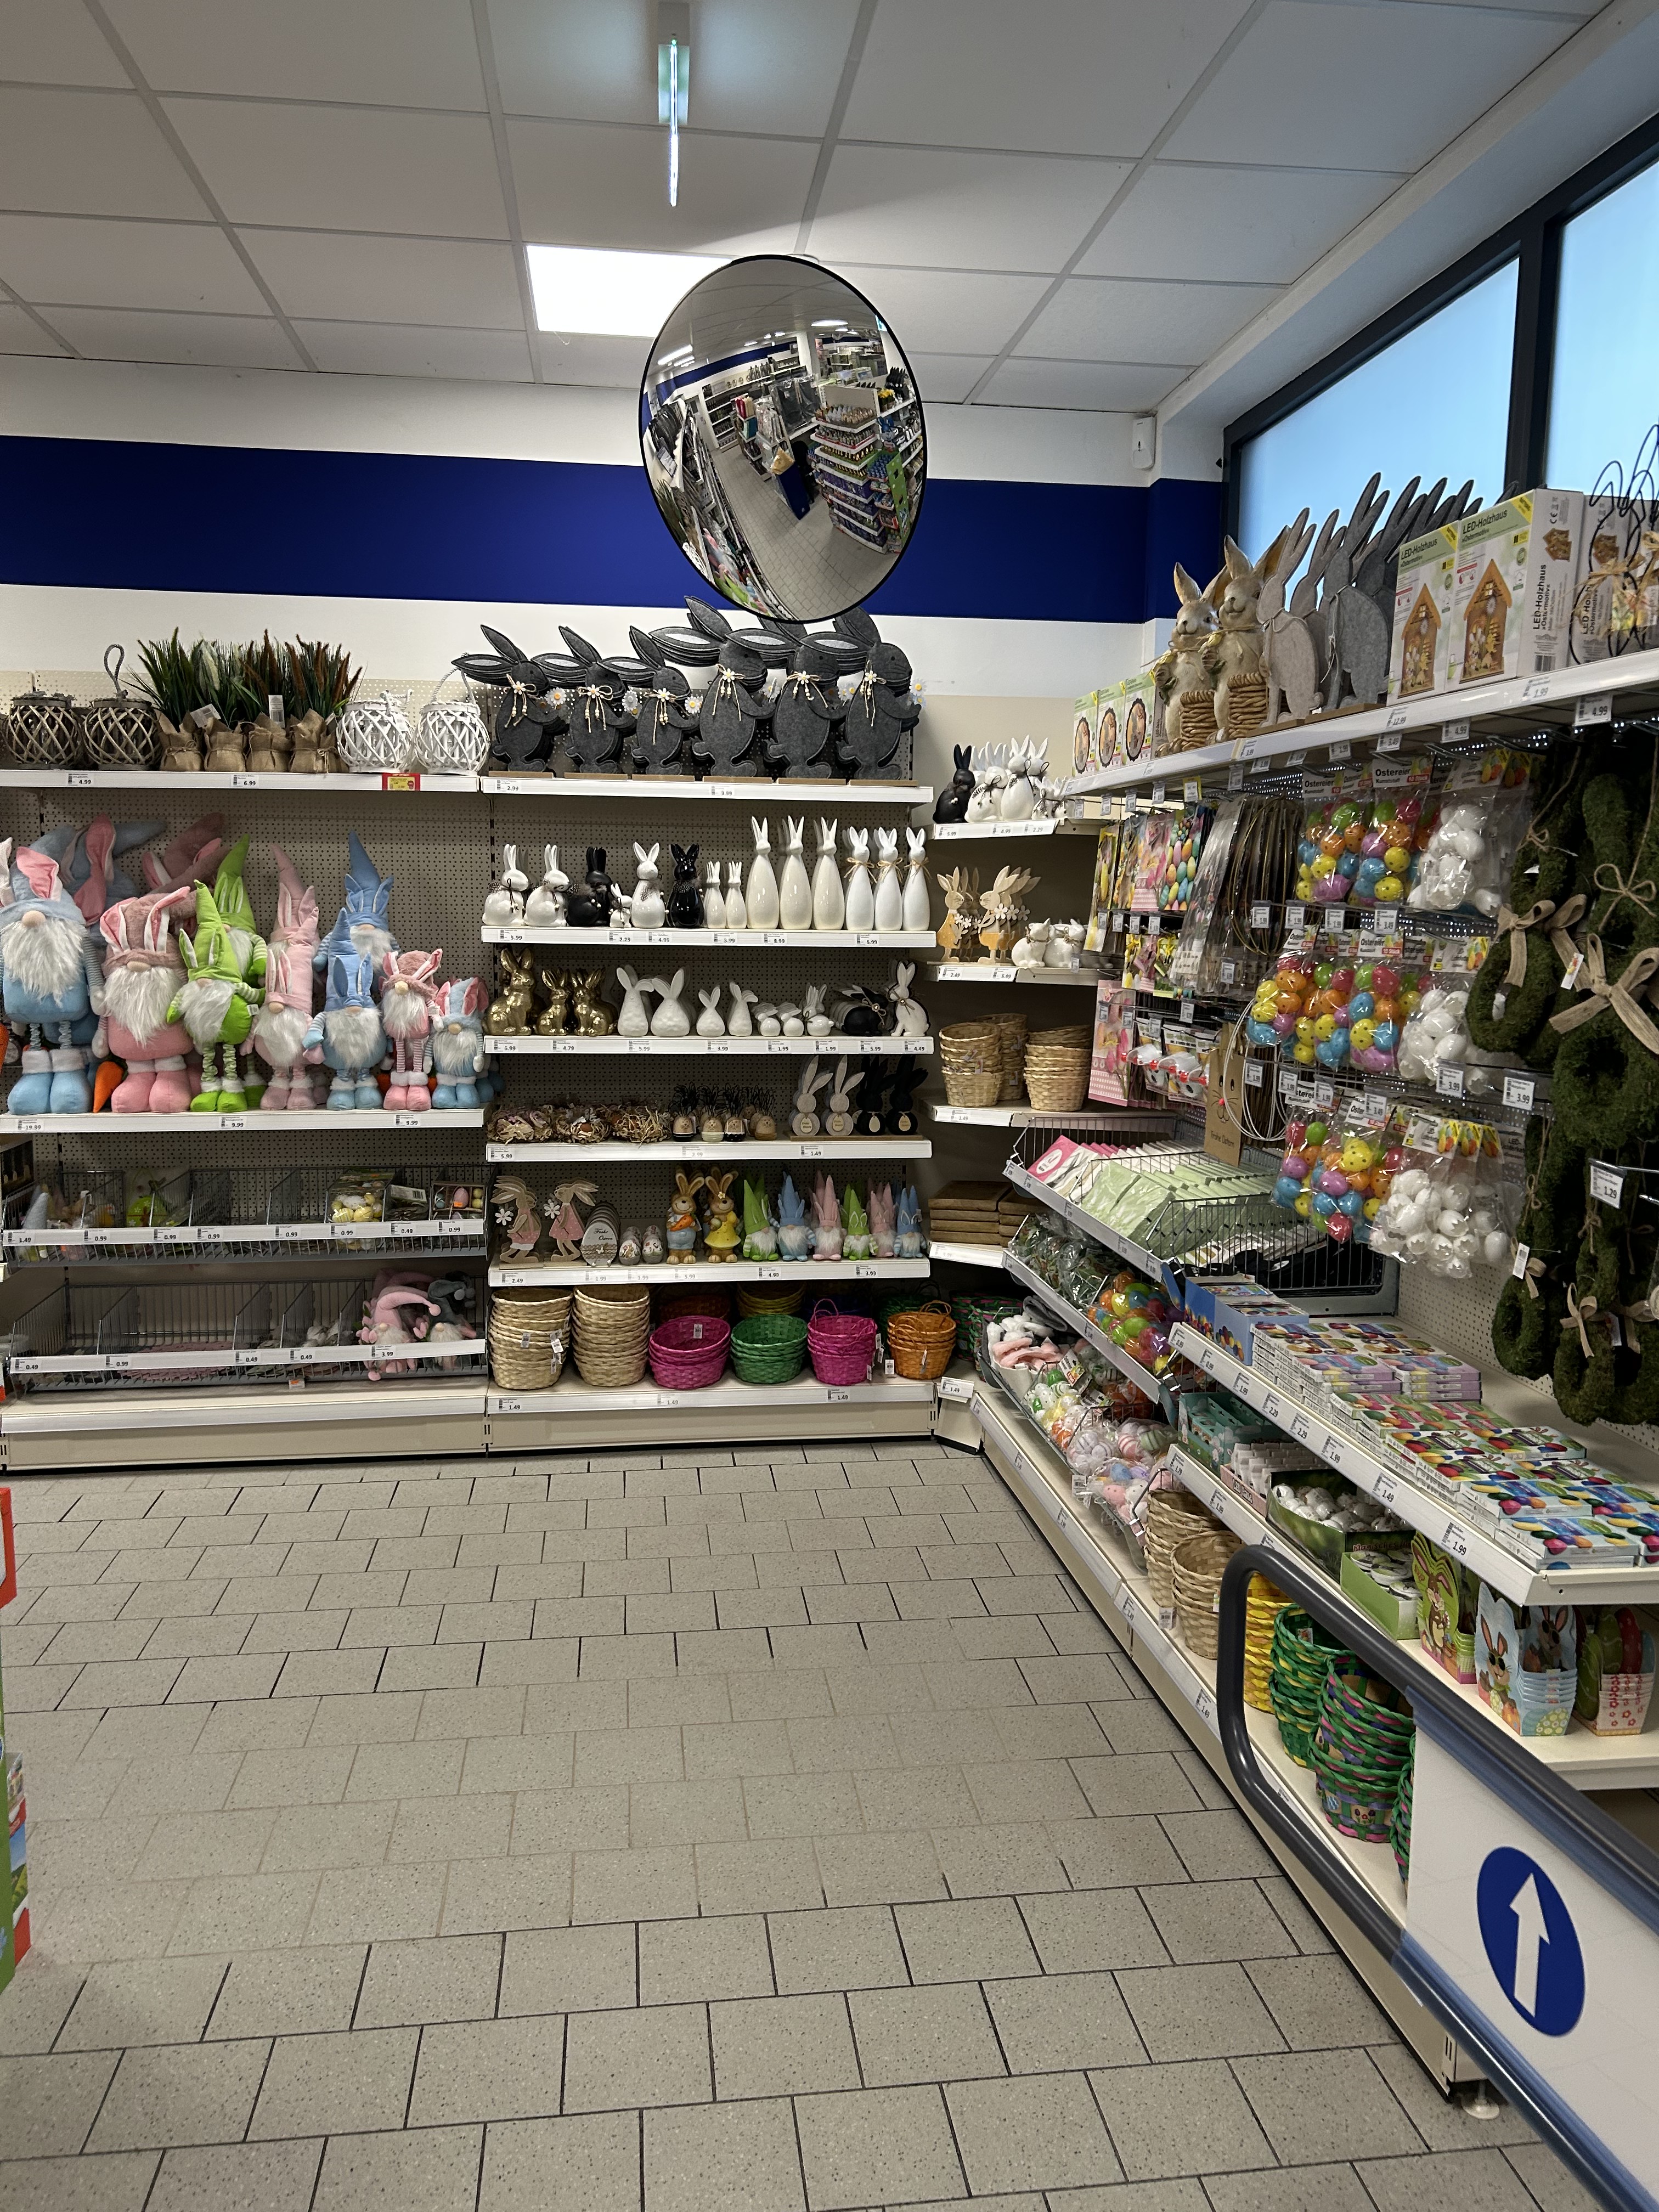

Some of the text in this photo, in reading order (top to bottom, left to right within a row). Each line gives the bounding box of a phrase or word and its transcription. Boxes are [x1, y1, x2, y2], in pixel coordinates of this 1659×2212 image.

[1463, 510, 1508, 534] LED-Holzhaus
[1401, 539, 1437, 560] LED-Holzhaus
[1533, 564, 1547, 630] LED-Holzhaus
[1592, 706, 1608, 716] 4.99
[1454, 725, 1467, 735] 4.99
[1375, 768, 1411, 777] Ostereier
[1361, 938, 1385, 946] Ostereier
[1449, 1081, 1459, 1091] 3.99
[1516, 1093, 1530, 1104] 3.99
[1350, 1105, 1364, 1115] Oster
[1240, 1386, 1248, 1395] 1.99
[1269, 1407, 1278, 1417] 2.29
[1297, 1428, 1307, 1438] 2.29
[1330, 1452, 1340, 1463] 1.99
[1382, 1490, 1394, 1502] 1.49
[1453, 1542, 1466, 1555] 1.99
